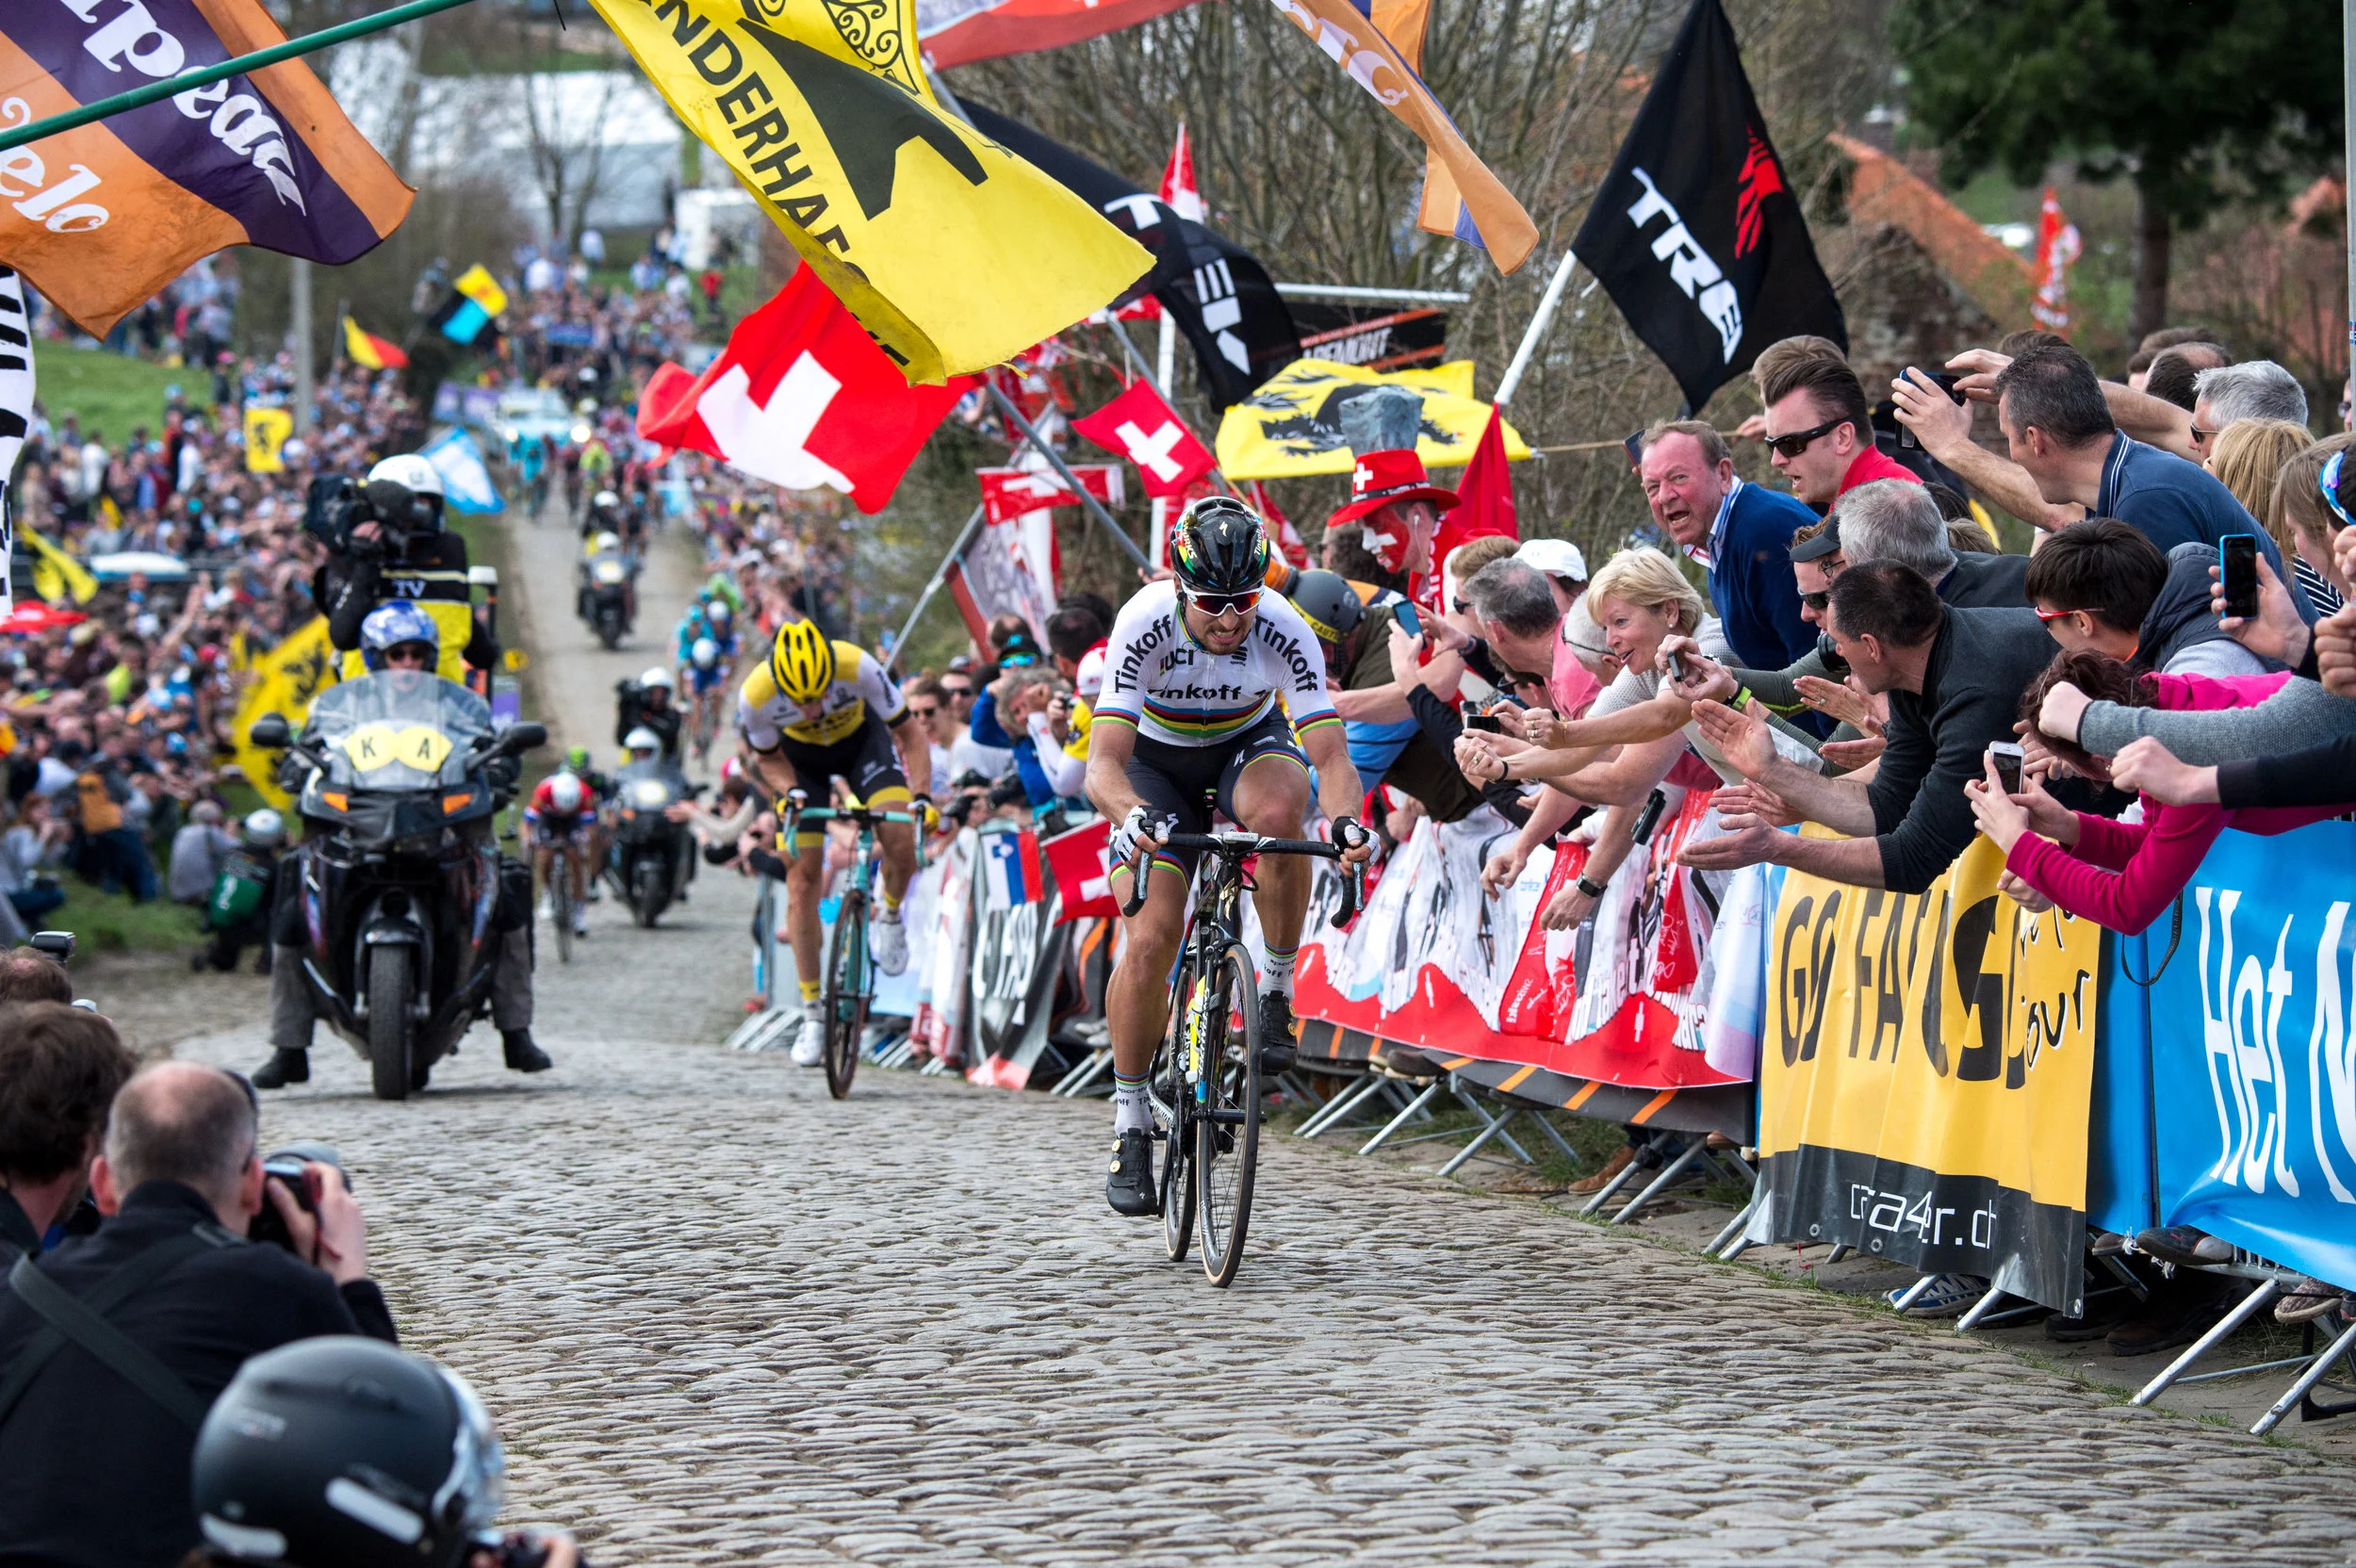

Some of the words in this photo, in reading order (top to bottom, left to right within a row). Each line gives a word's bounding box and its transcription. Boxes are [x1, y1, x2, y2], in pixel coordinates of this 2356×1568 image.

[391, 580, 425, 597] TV
[1115, 614, 1172, 694] Tinkoff
[1163, 648, 1194, 672] UCI
[1255, 614, 1318, 693] Tinkoff
[361, 736, 376, 759] K
[417, 736, 431, 759] A
[2196, 887, 2299, 1198] Het
